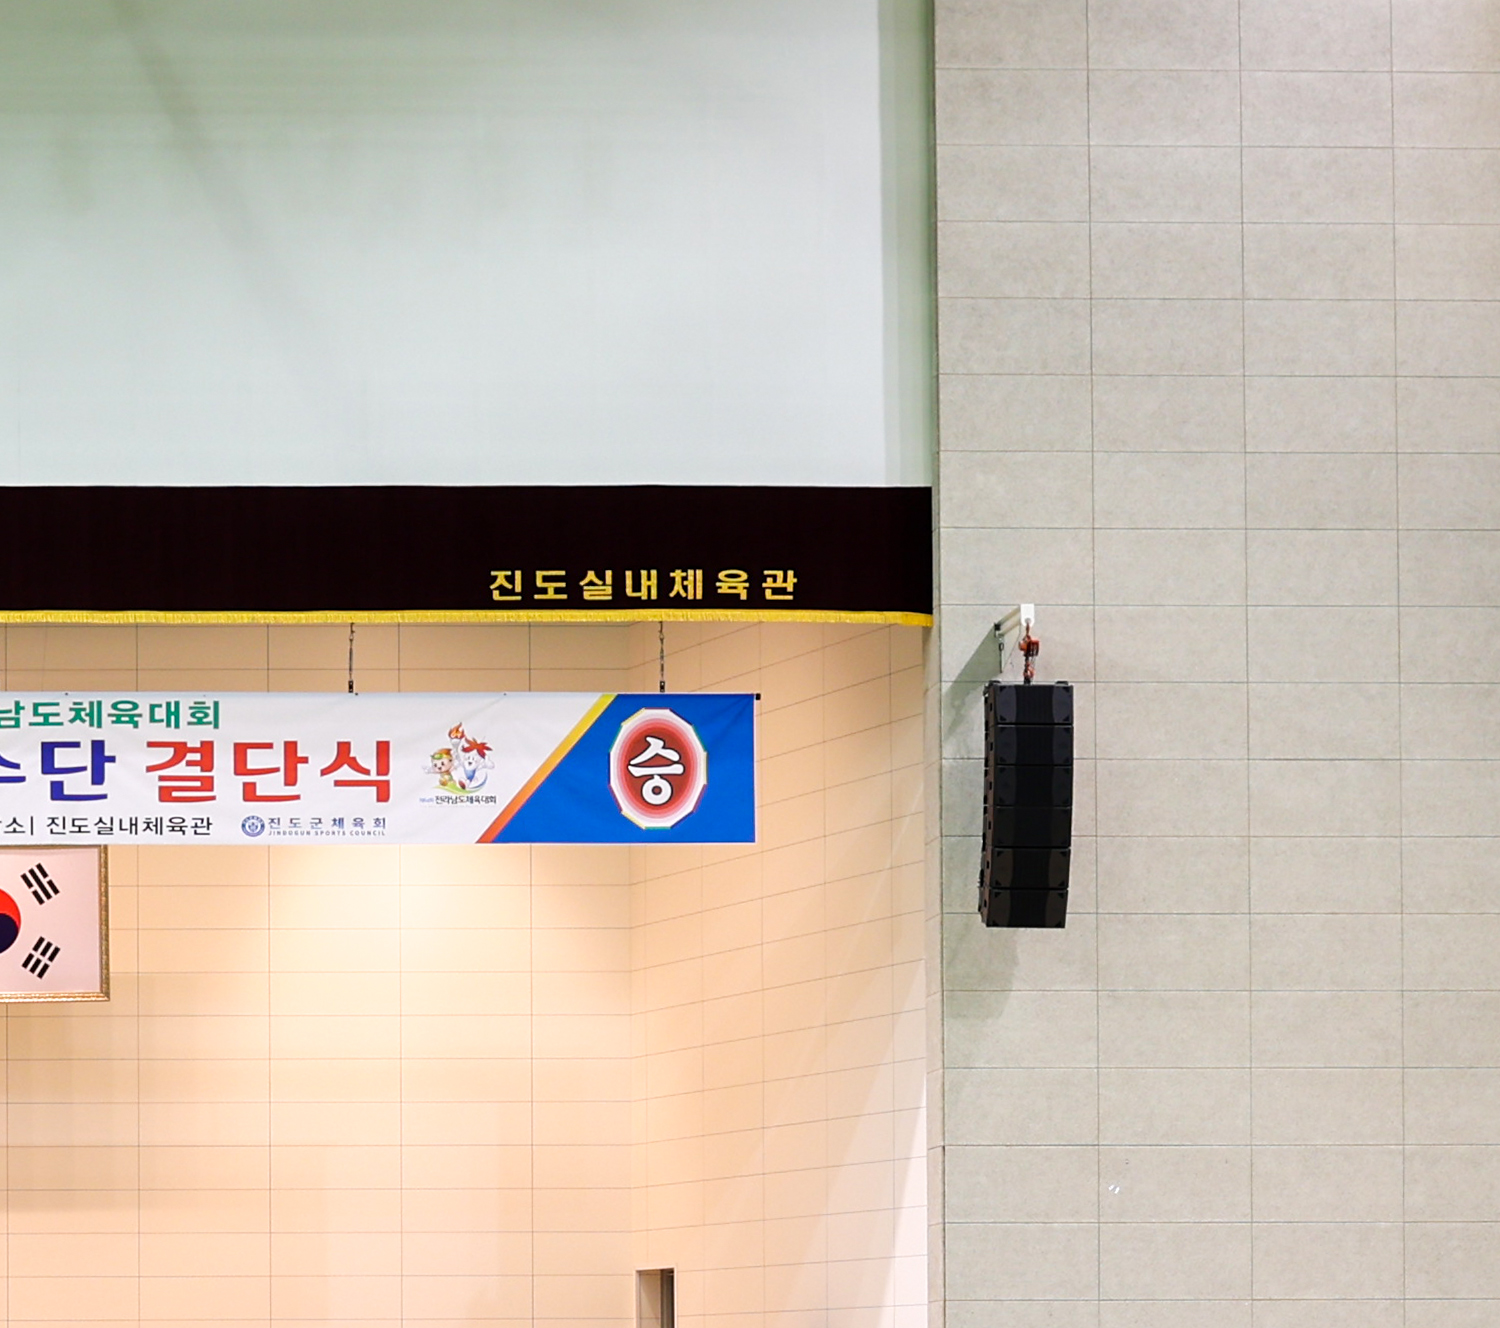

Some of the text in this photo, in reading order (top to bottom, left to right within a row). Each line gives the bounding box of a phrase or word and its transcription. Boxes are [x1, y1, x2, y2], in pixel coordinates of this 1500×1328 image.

[489, 569, 798, 600] 진도실내체육관
[145, 740, 391, 803] 결단식
[627, 736, 686, 806] 승
[46, 816, 213, 837] 진도실내체육관
[268, 817, 386, 829] 진도군체육회
